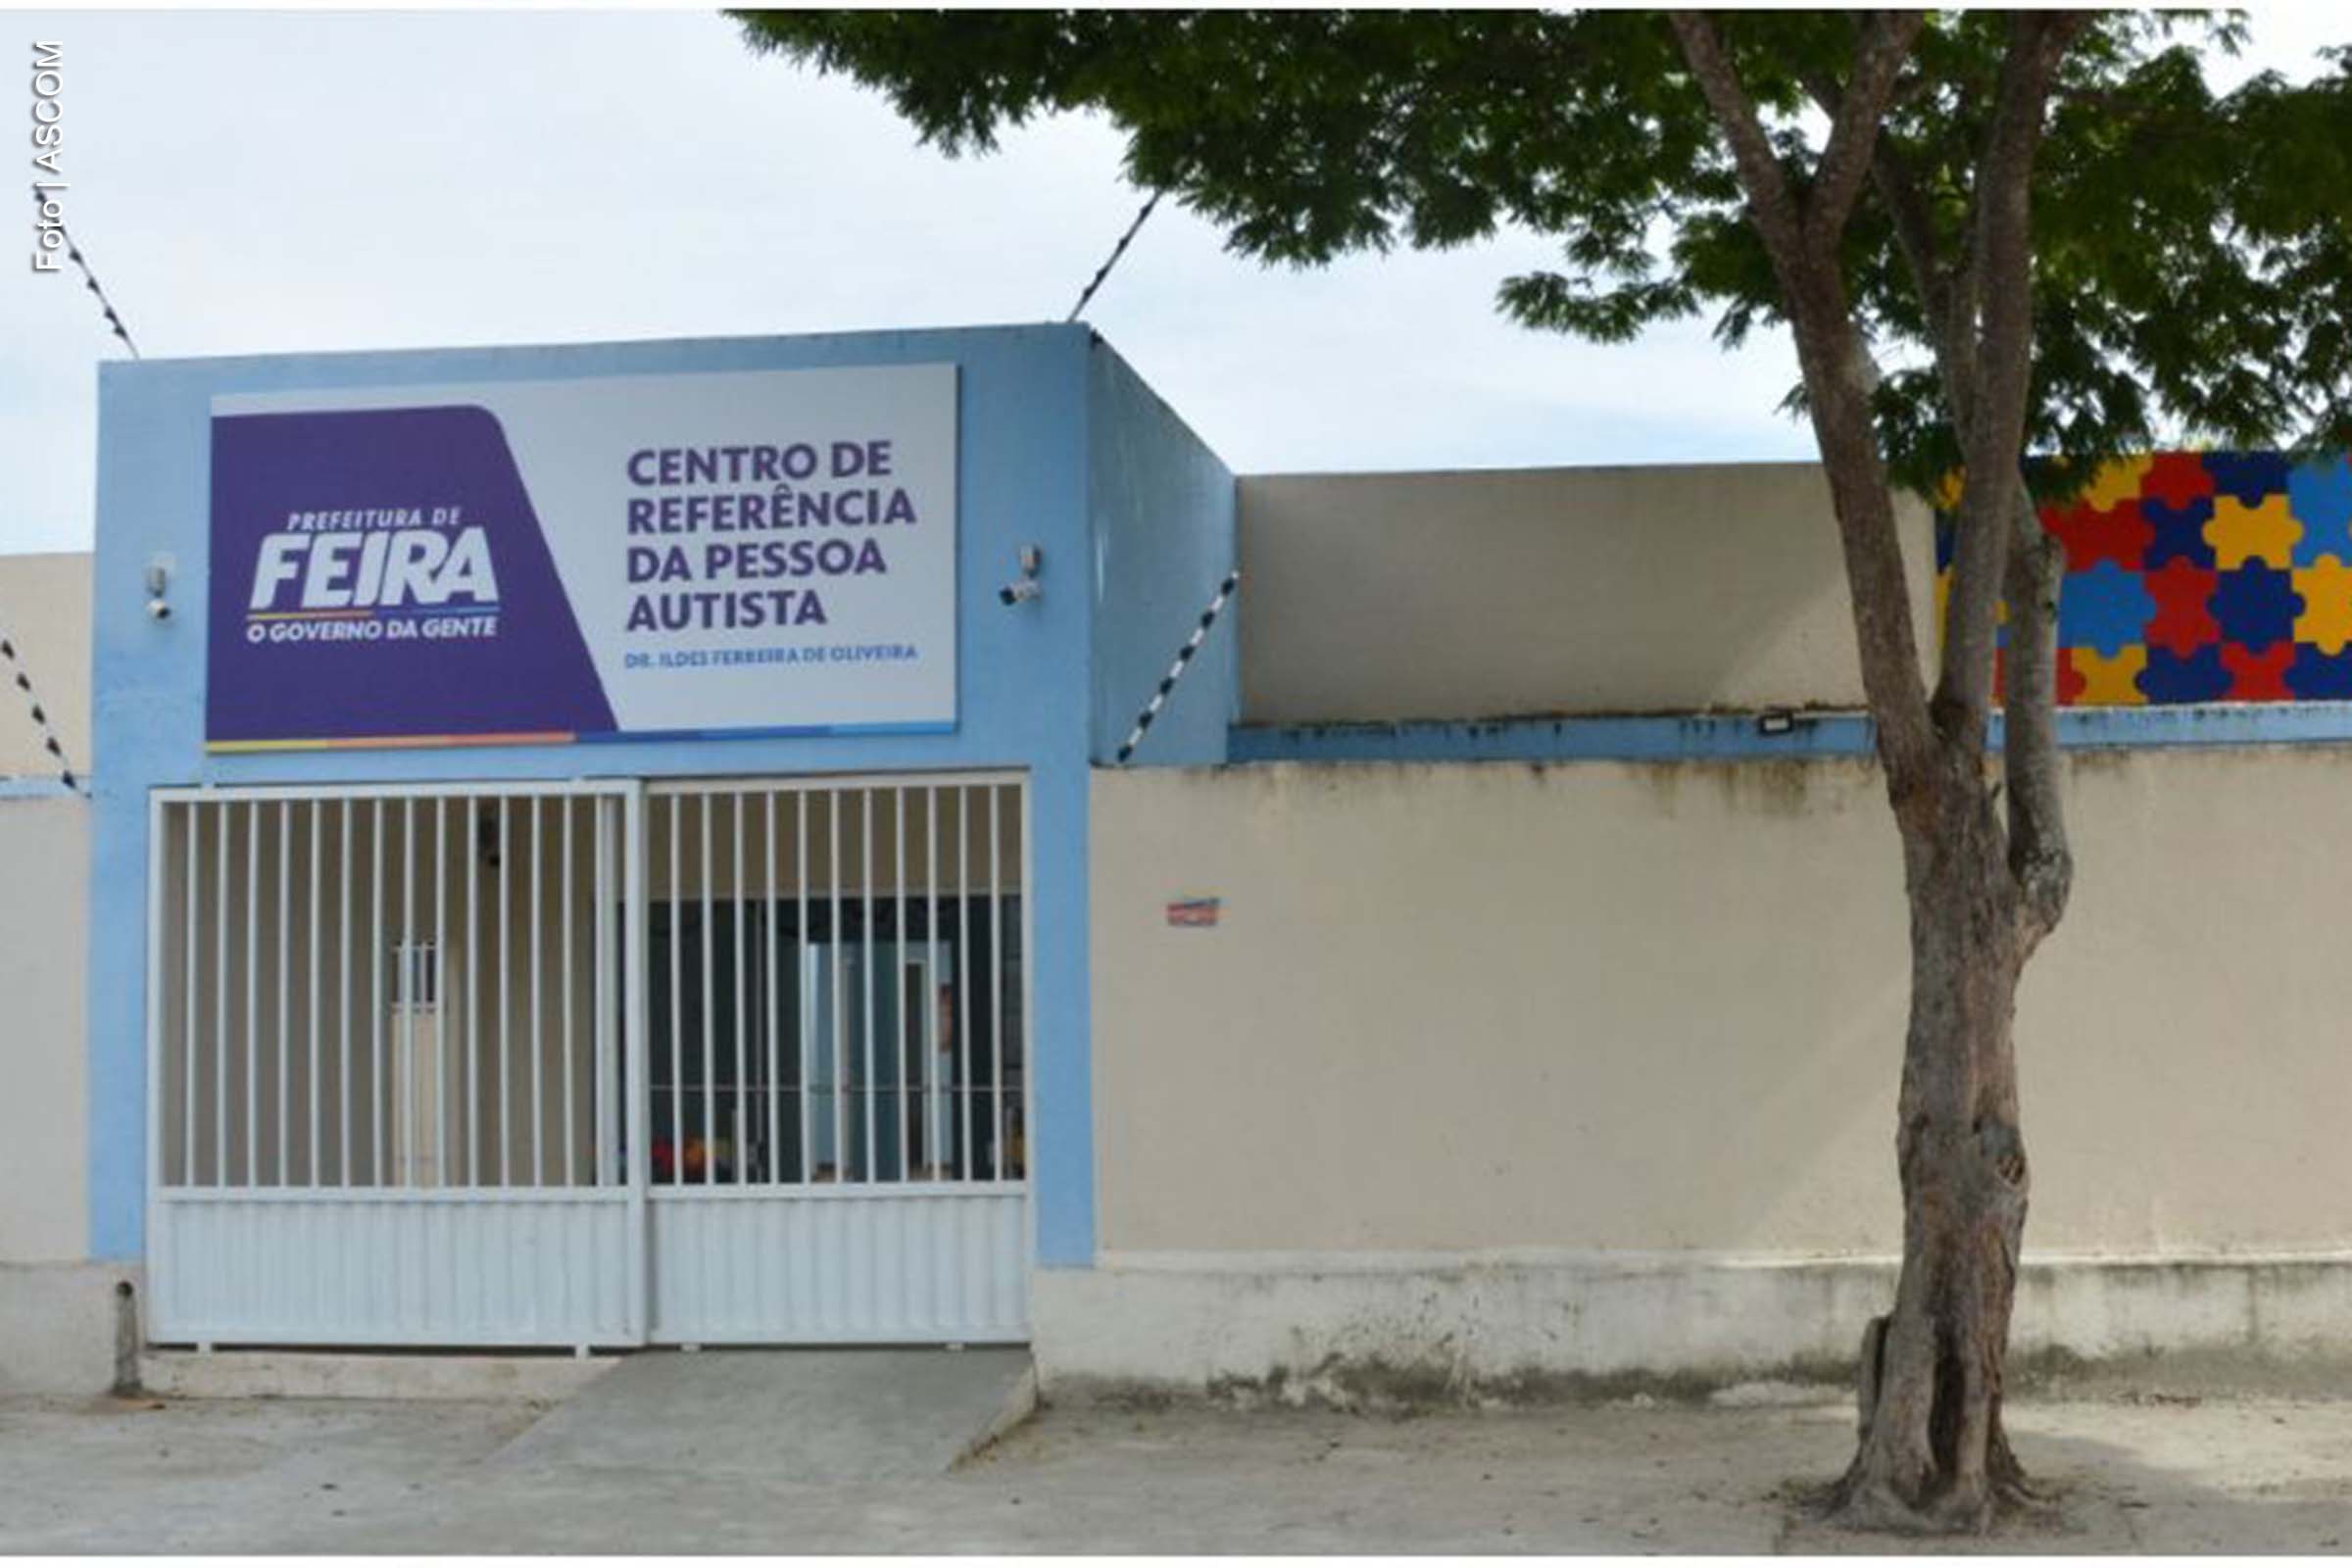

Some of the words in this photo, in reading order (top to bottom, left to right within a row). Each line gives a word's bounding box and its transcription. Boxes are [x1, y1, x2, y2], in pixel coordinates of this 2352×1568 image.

[627, 443, 817, 486] CENTRO
[831, 440, 892, 478] DE
[287, 508, 421, 530] PREFEITURA
[432, 507, 461, 525] DE
[627, 483, 917, 535] REFERÊNCIA
[248, 526, 500, 608] FEIRA
[627, 545, 692, 583] DA
[706, 538, 887, 580] PESSOA
[247, 621, 267, 643] O
[270, 619, 383, 641] GOVERNO
[387, 618, 418, 638] DA
[422, 616, 497, 637] GENTE
[626, 589, 827, 632] AUTISTA
[625, 653, 658, 669] DR.
[660, 651, 709, 668] ILDES
[712, 647, 798, 665] FERREIRA
[803, 646, 825, 662] DE
[830, 644, 917, 662] OLIVEIRA
